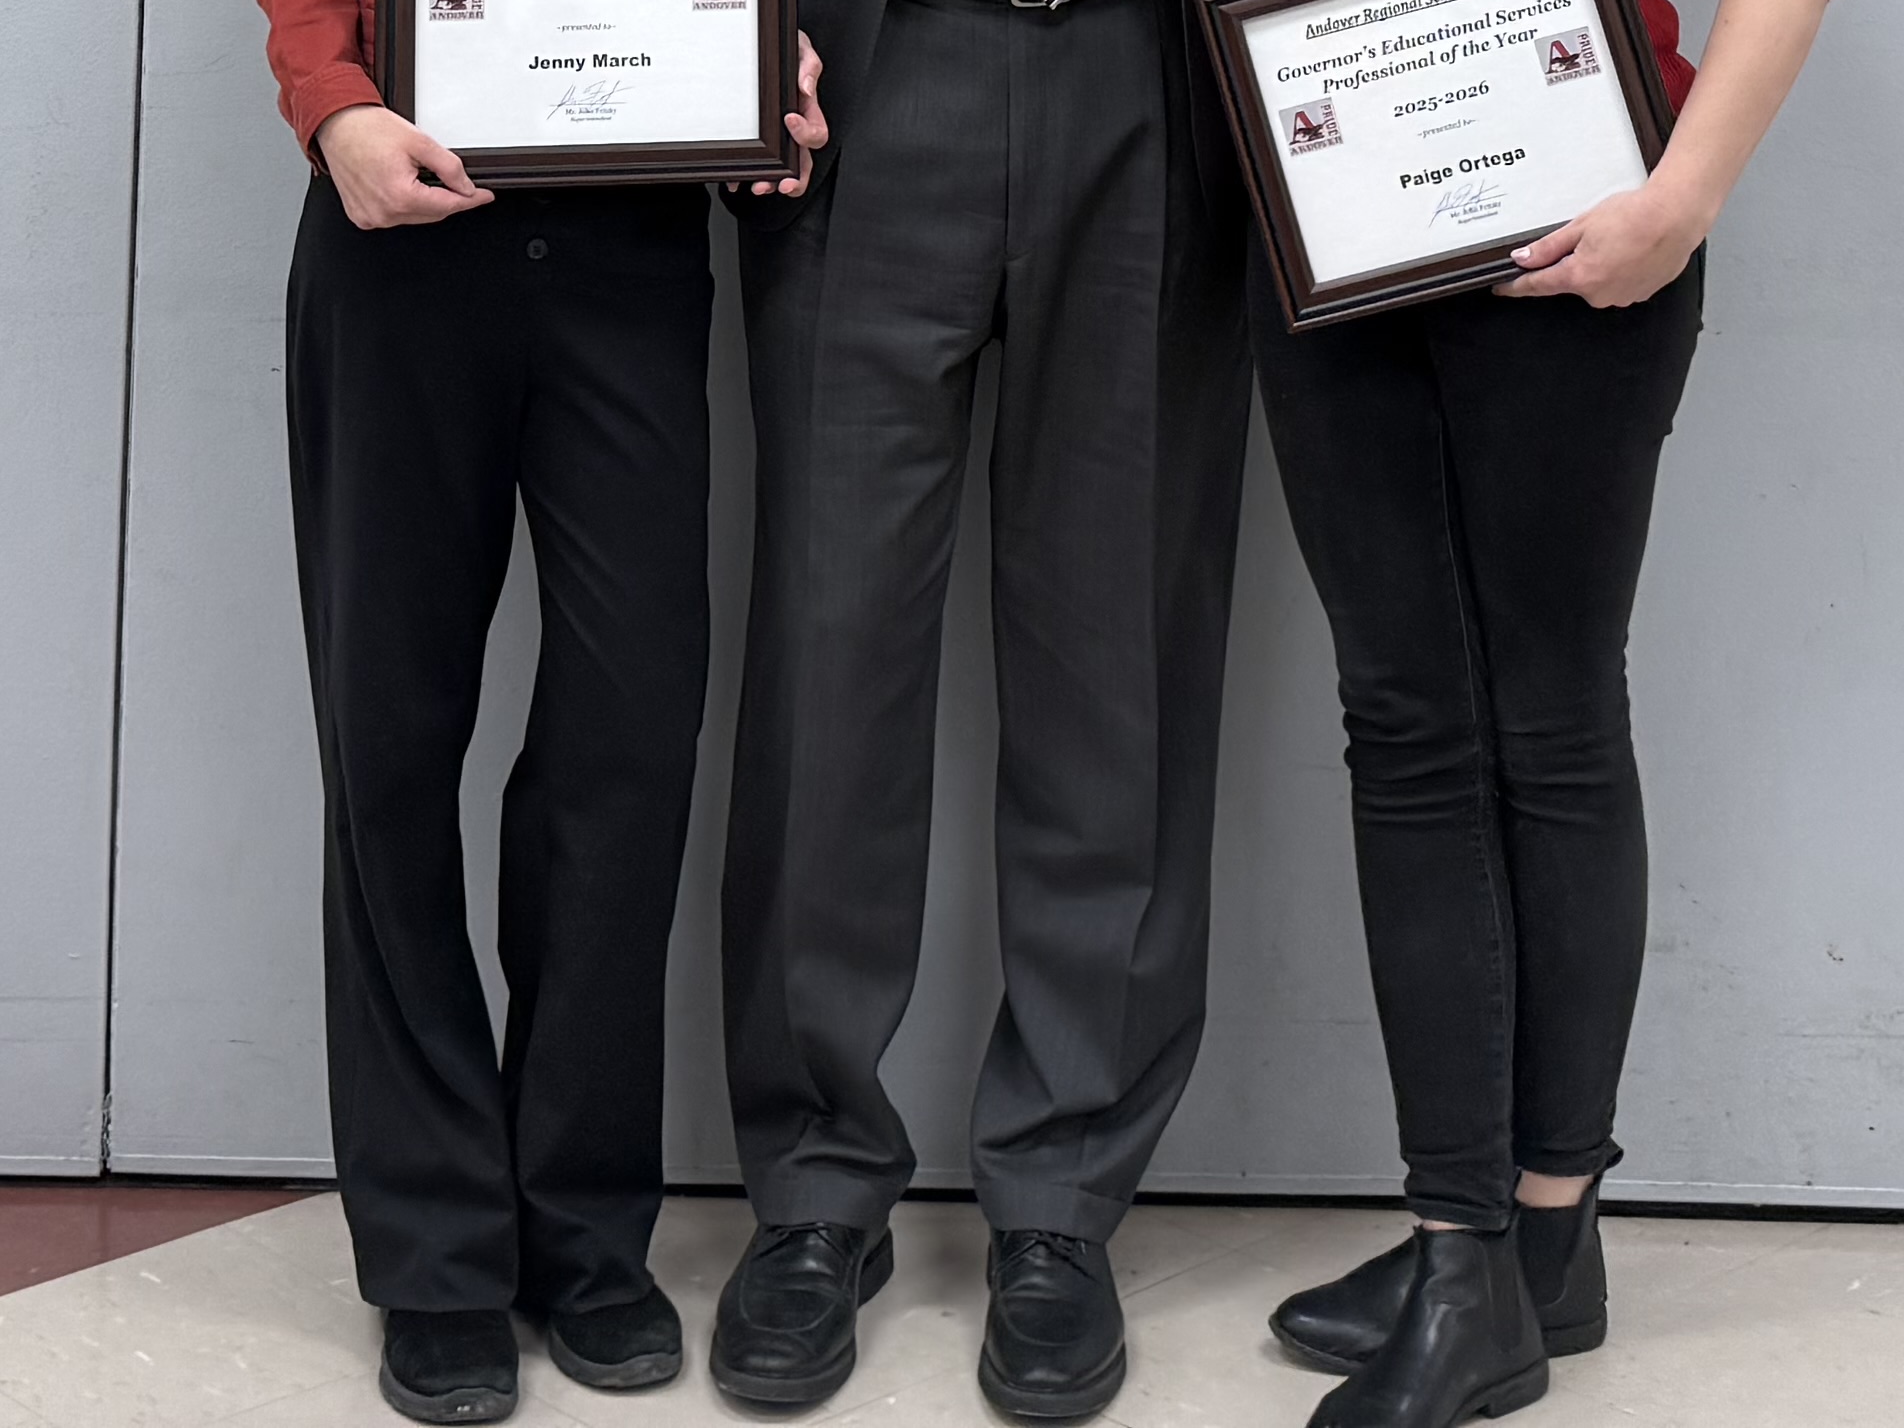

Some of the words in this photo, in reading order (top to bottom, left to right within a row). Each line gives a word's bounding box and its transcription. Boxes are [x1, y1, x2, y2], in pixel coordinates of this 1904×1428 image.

[1305, 13, 1360, 40] Andover
[528, 56, 586, 72] Jenny
[592, 53, 651, 68] March
[1277, 46, 1376, 82] Governor's
[1381, 13, 1492, 55] Educational
[1323, 51, 1436, 93] Professional
[1440, 44, 1460, 64] of
[1462, 40, 1492, 57] the
[1494, 28, 1538, 49] Year
[1577, 33, 1596, 65] PRIDE
[1394, 80, 1489, 117] 2025-2026
[1320, 104, 1339, 136] PRIDE
[1400, 167, 1453, 189] Paige
[1459, 148, 1526, 173] Ortega
